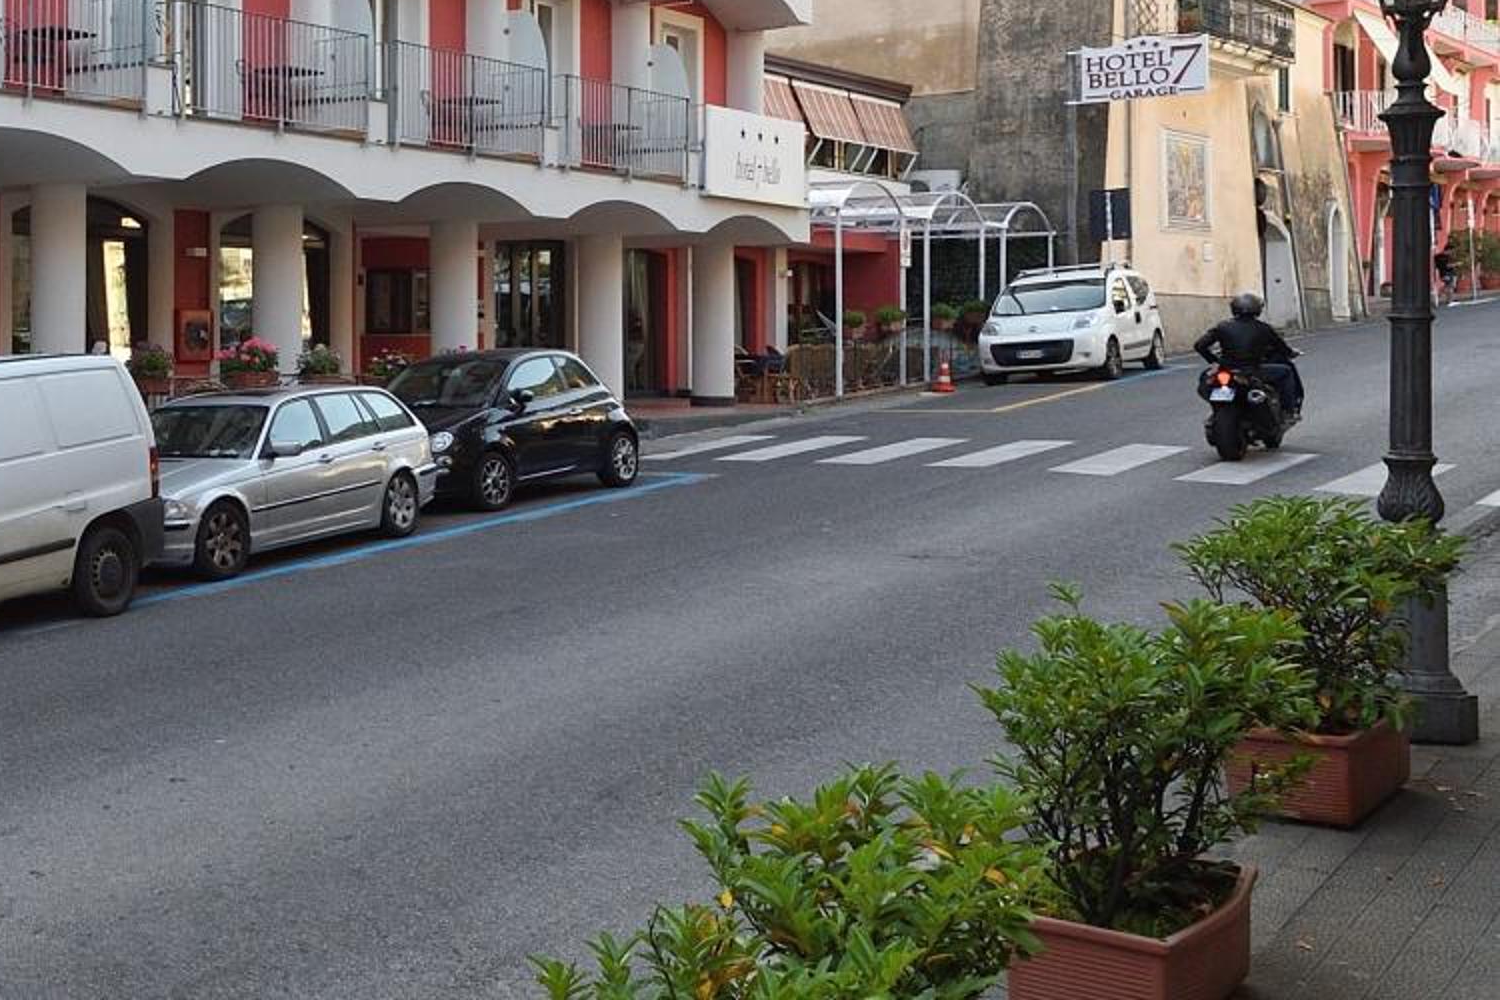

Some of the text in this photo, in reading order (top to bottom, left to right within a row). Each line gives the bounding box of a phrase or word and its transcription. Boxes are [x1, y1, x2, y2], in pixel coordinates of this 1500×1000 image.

[1087, 43, 1203, 85] HOTEL 7
[1089, 67, 1170, 89] BELLO
[1110, 87, 1178, 100] GARAGE
